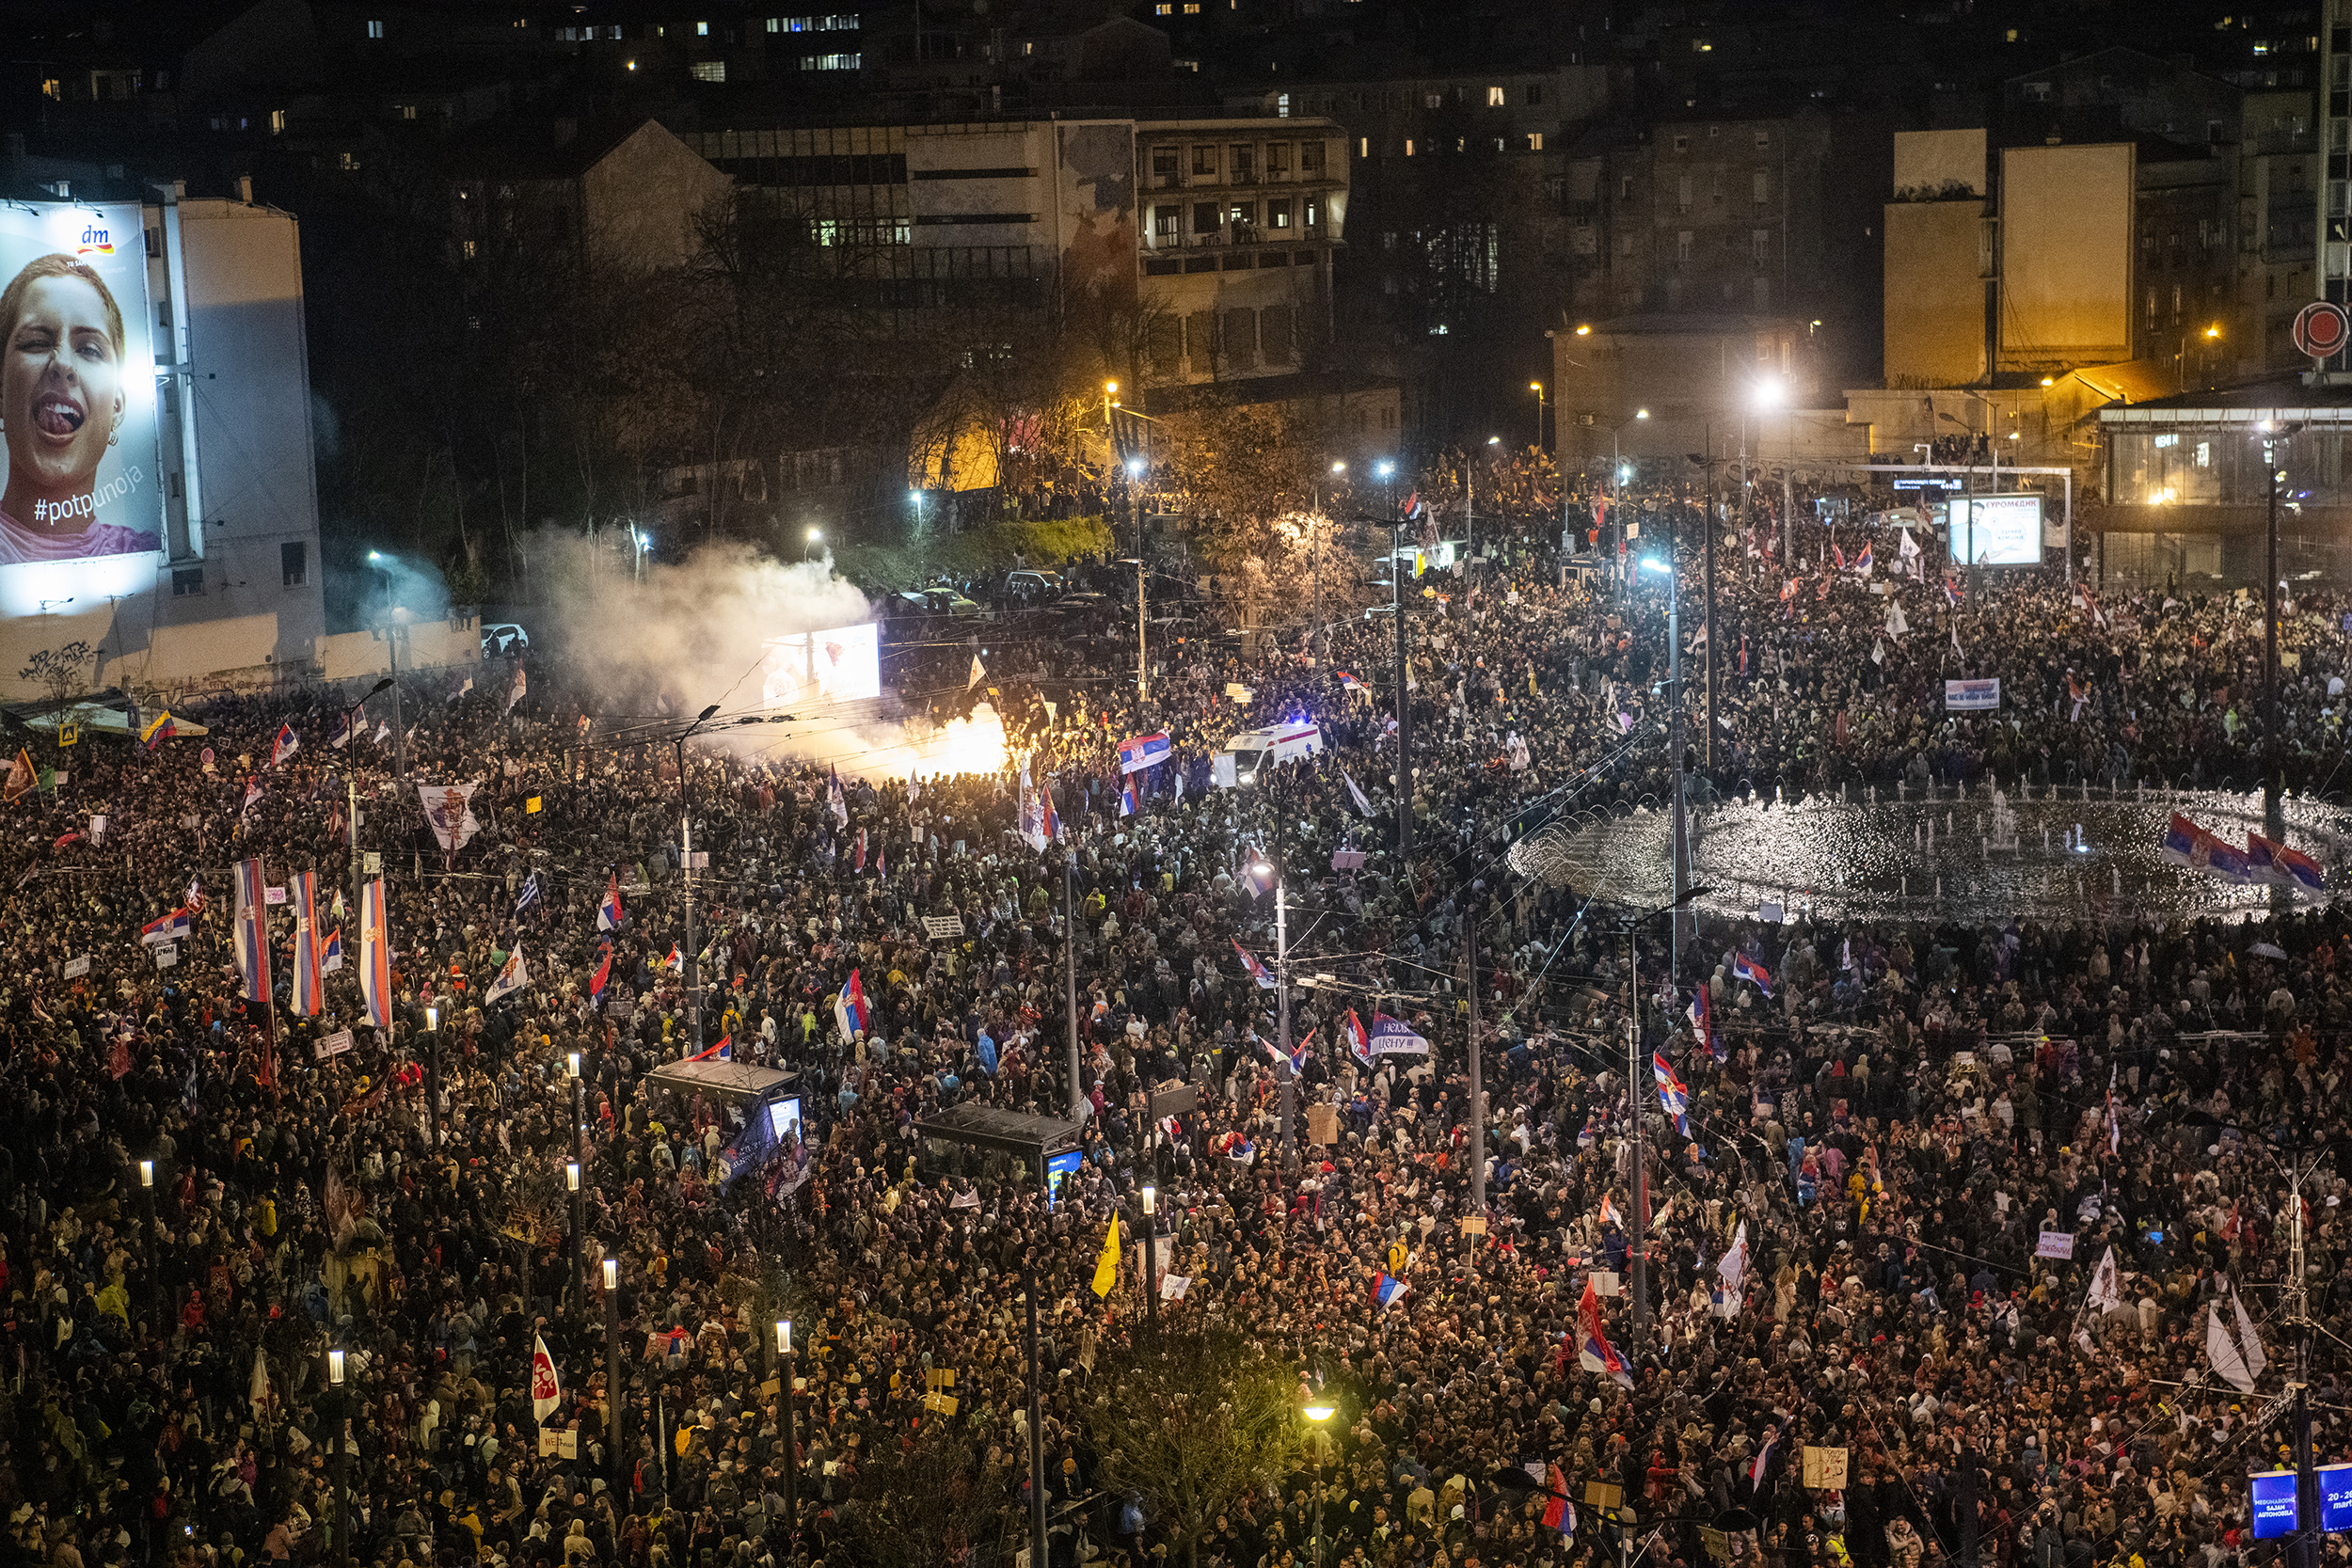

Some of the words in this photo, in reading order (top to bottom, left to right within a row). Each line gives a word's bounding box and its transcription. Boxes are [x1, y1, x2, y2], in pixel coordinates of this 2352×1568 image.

[82, 225, 108, 244] dm
[34, 466, 144, 526] #potpunoja
[1378, 1038, 1406, 1051] ЦЕНУ
